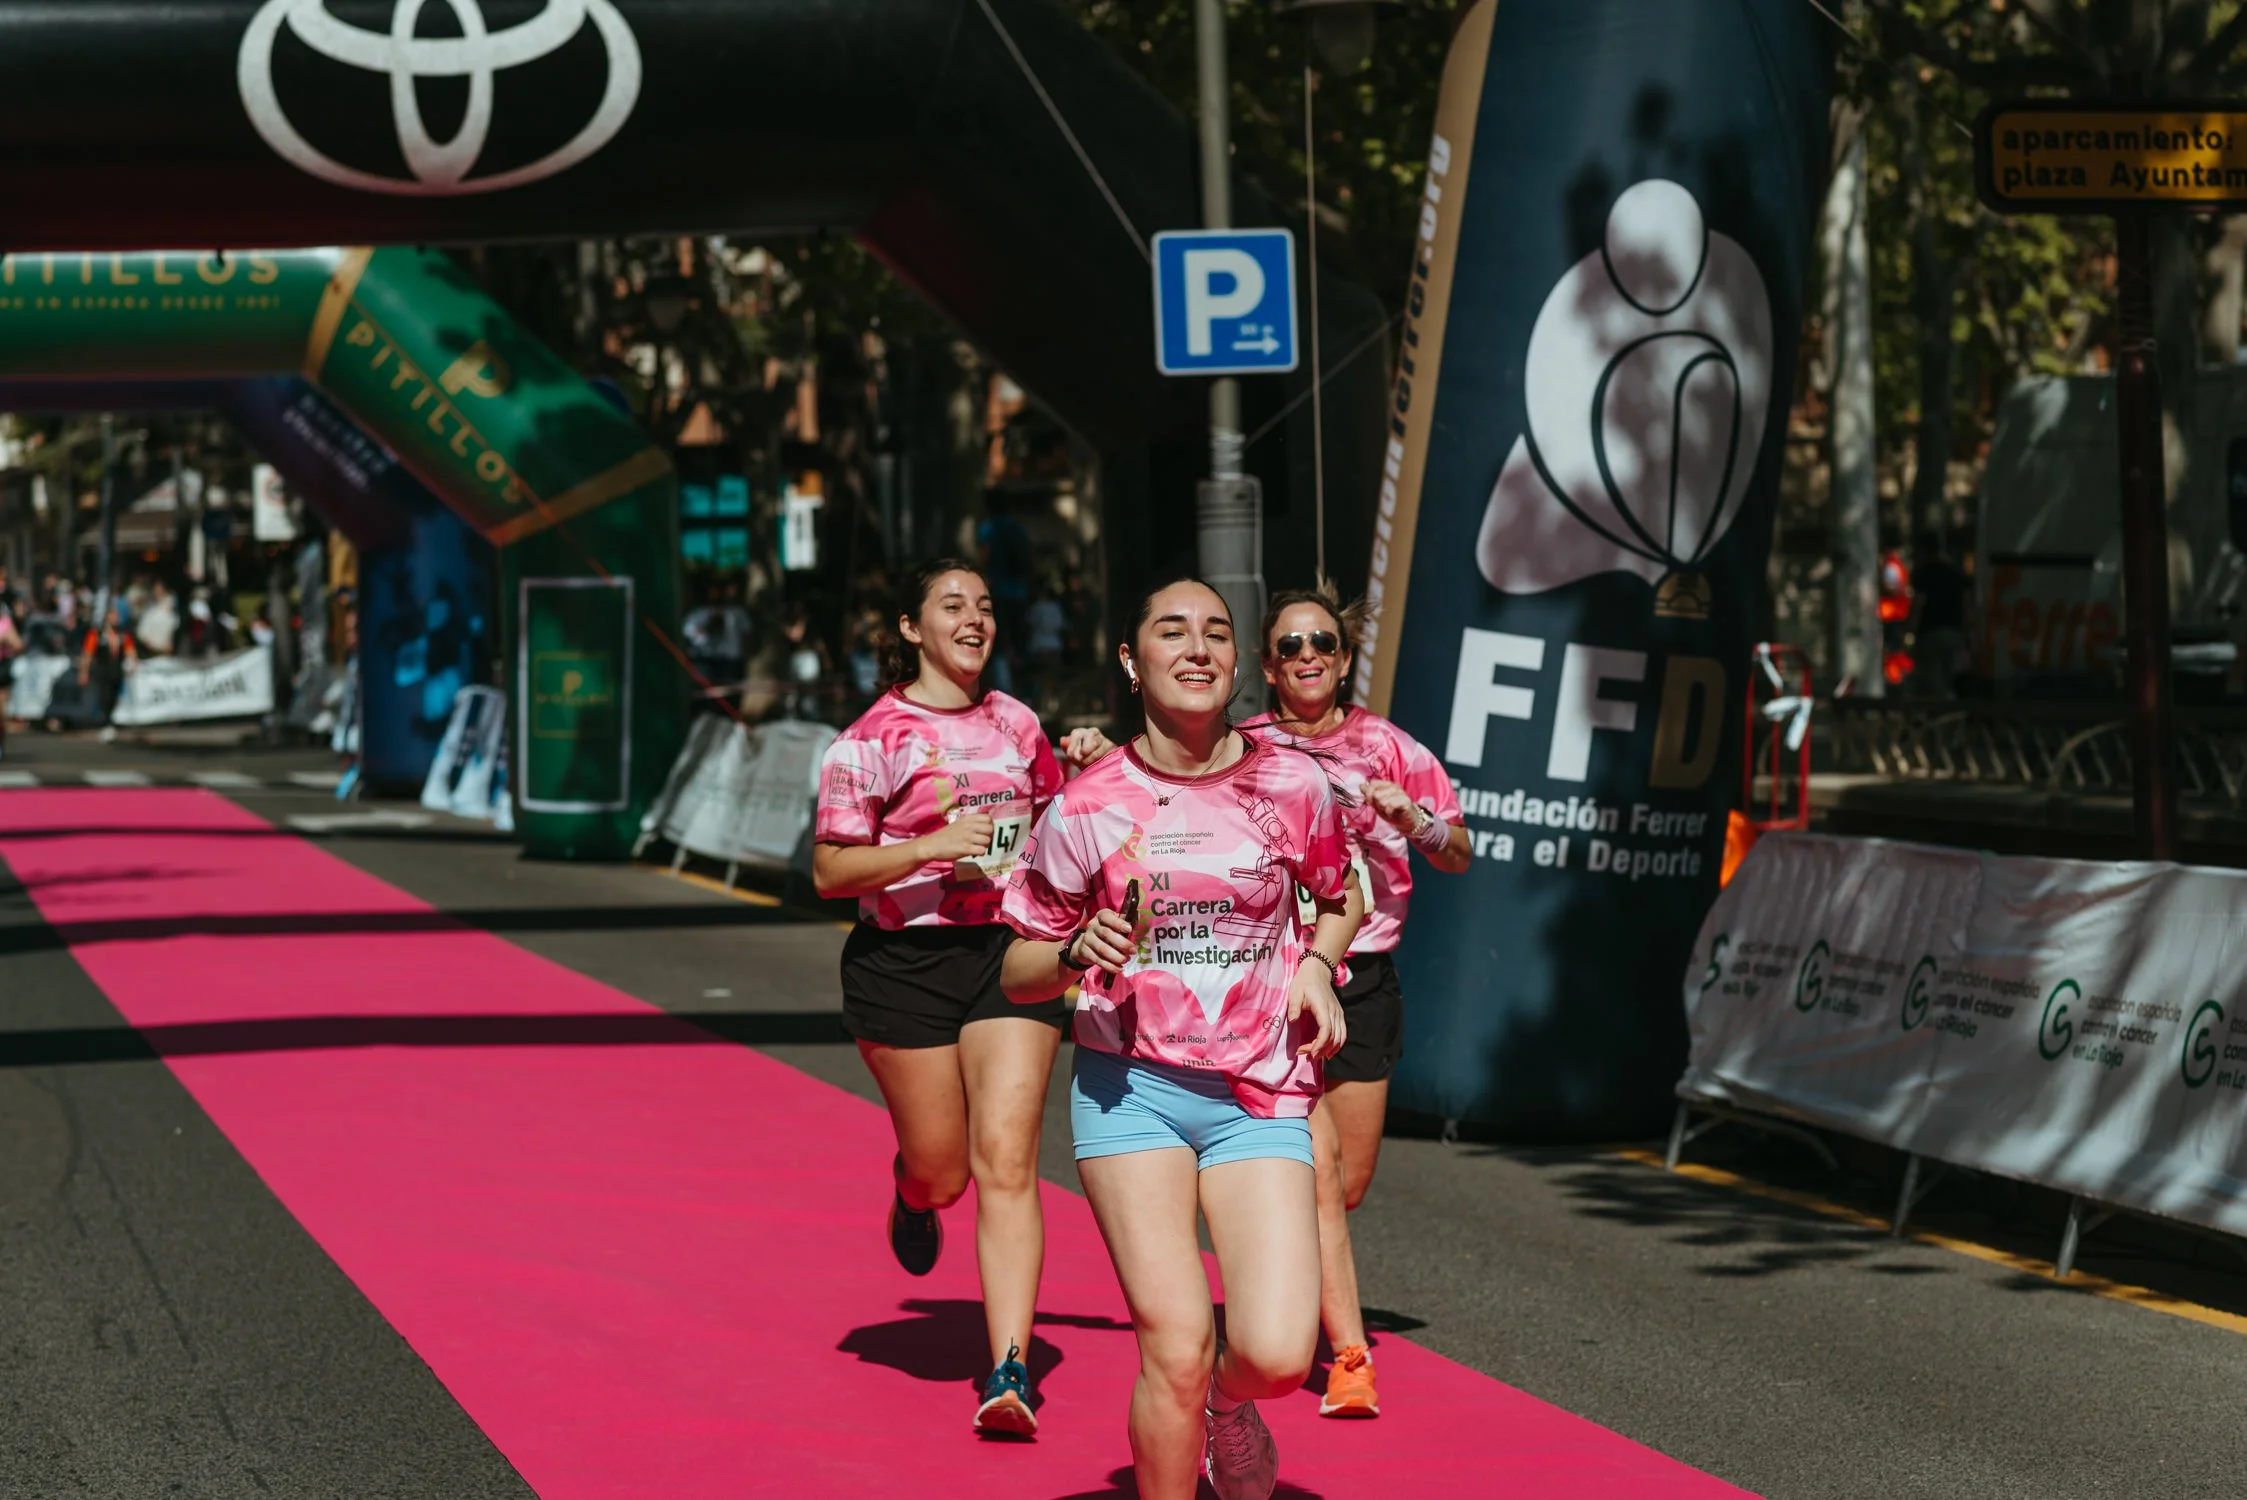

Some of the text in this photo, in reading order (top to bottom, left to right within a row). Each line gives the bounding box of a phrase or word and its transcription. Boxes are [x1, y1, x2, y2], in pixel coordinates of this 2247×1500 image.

[2003, 162, 2086, 193] plaza
[1184, 249, 1265, 356] P
[346, 320, 523, 503] PITILLOS
[1445, 626, 1727, 790] FFD
[953, 773, 970, 789] XI
[958, 790, 1013, 807] Carrera
[1630, 803, 1708, 838] Ferrer
[1150, 831, 1214, 840] asociación española
[1170, 847, 1186, 855] Rioja
[1533, 835, 1571, 868] el
[1587, 838, 1702, 881] Deporte
[1150, 872, 1170, 892] XI
[1151, 897, 1231, 917] Carrera
[1154, 920, 1209, 943] por la
[1178, 1035, 1206, 1044] La Rioja
